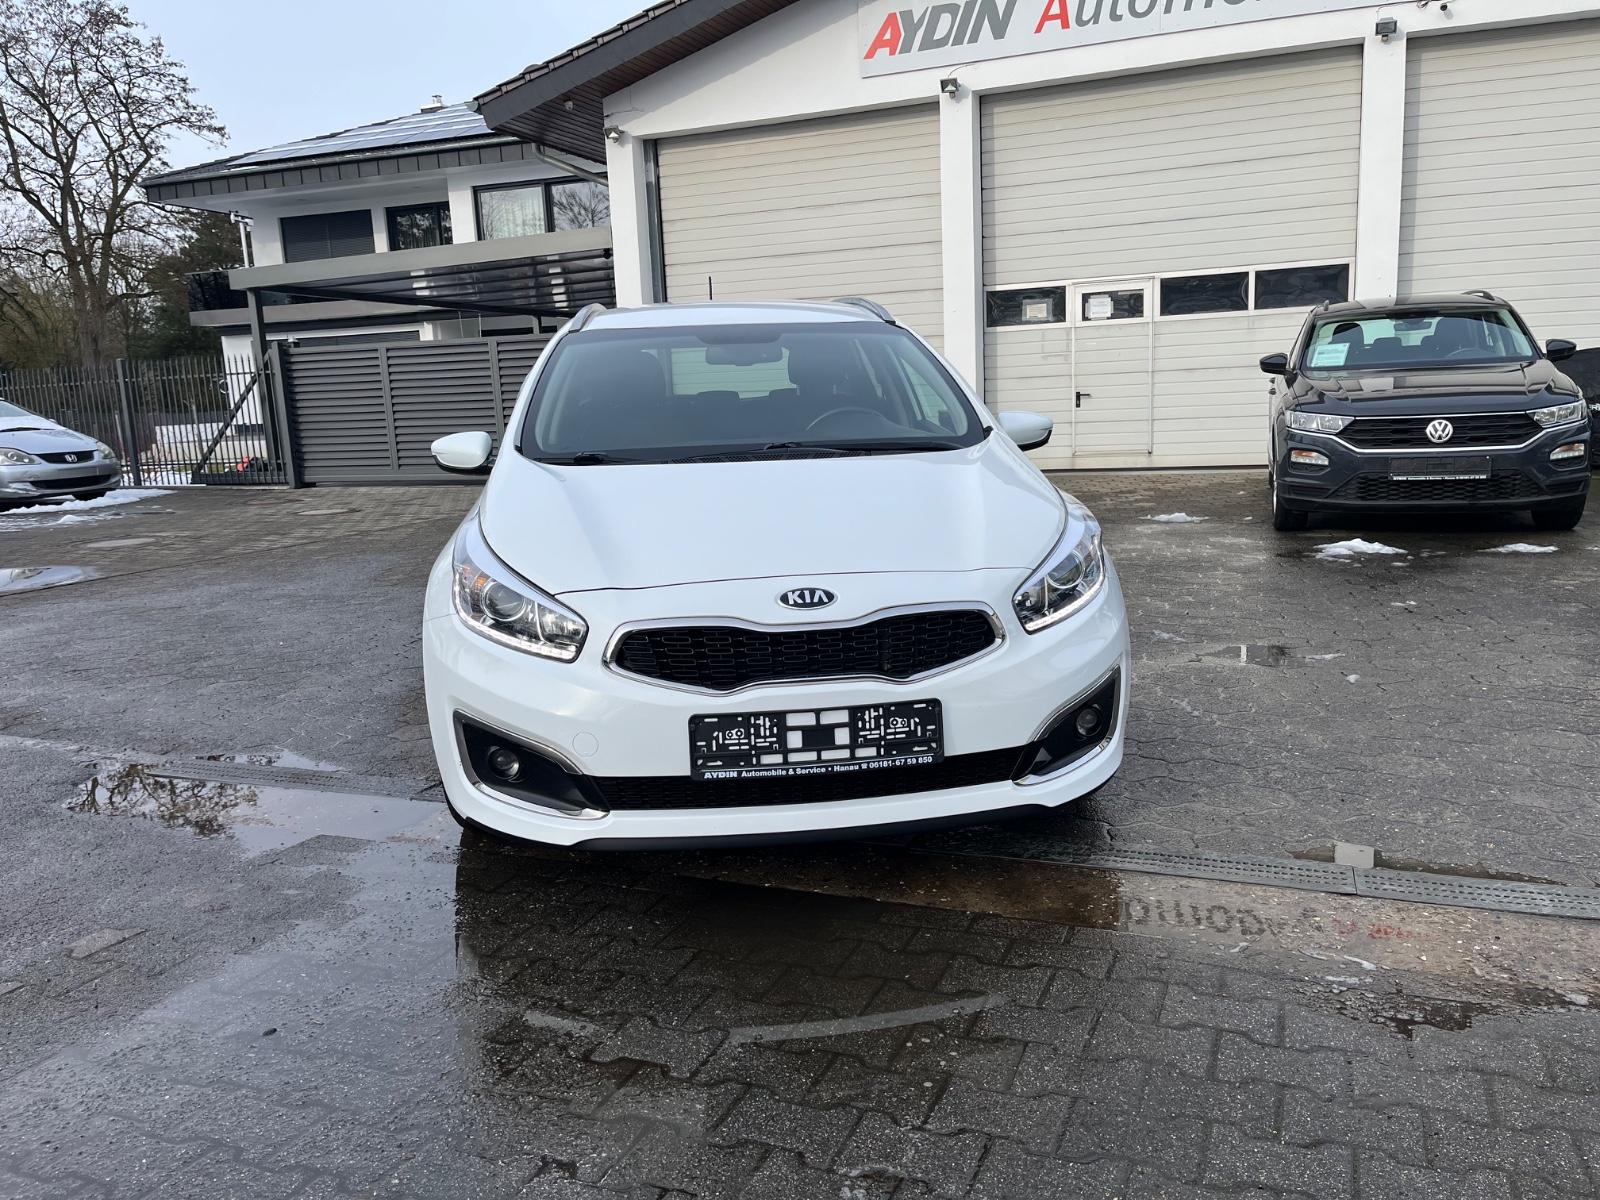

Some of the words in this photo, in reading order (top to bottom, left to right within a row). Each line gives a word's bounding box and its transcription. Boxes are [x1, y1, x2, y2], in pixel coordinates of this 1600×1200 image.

[864, 0, 1017, 59] AYDIN
[786, 589, 829, 605] KIA
[704, 771, 738, 779] AYDIN
[741, 768, 787, 777] Automobile
[795, 766, 826, 775] Service
[833, 764, 859, 772] Hanau
